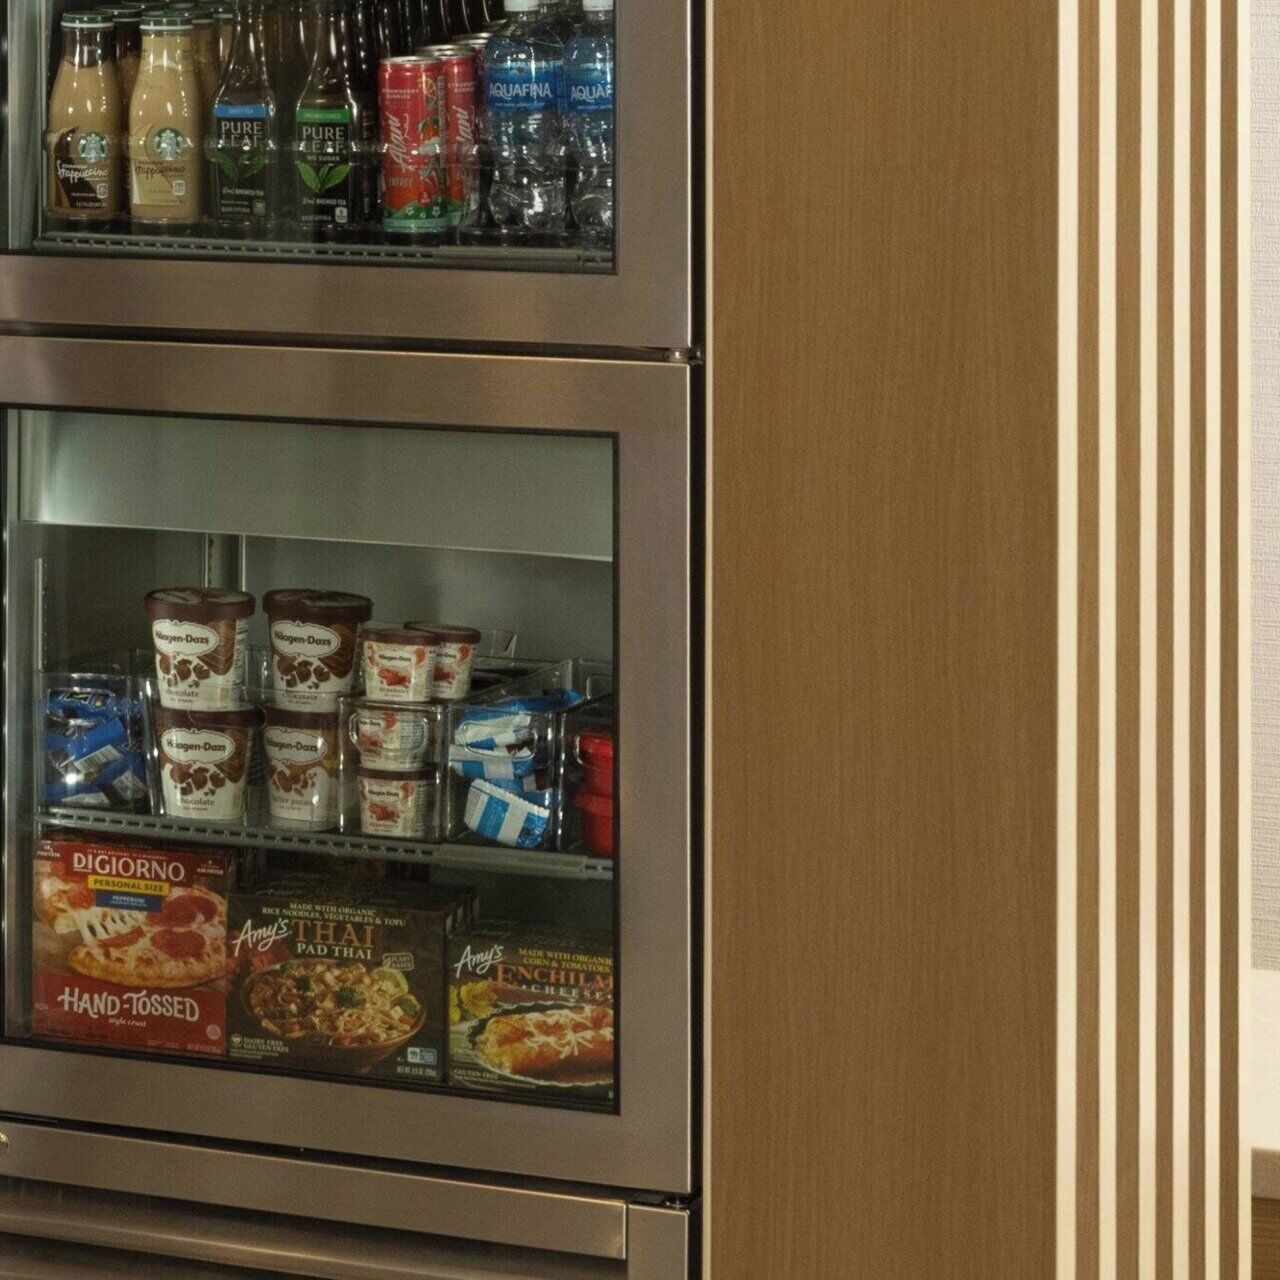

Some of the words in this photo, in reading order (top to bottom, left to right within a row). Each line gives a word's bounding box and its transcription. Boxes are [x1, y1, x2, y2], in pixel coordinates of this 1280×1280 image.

[490, 83, 552, 99] AQUAFINA
[221, 121, 263, 135] PURE
[302, 127, 345, 140] PURE
[307, 154, 317, 162] NO
[319, 154, 340, 162] SUGAR
[93, 878, 142, 891] PERSONAL
[144, 883, 164, 893] SIZE
[232, 918, 290, 957] Amy's
[295, 920, 374, 949] THAI
[297, 943, 328, 956] PAD
[334, 946, 372, 960] THAI
[454, 943, 504, 977] Amy's
[522, 957, 548, 967] CORN
[532, 984, 604, 1000] CHEESE
[57, 987, 200, 1022] HAND-TOSSED
